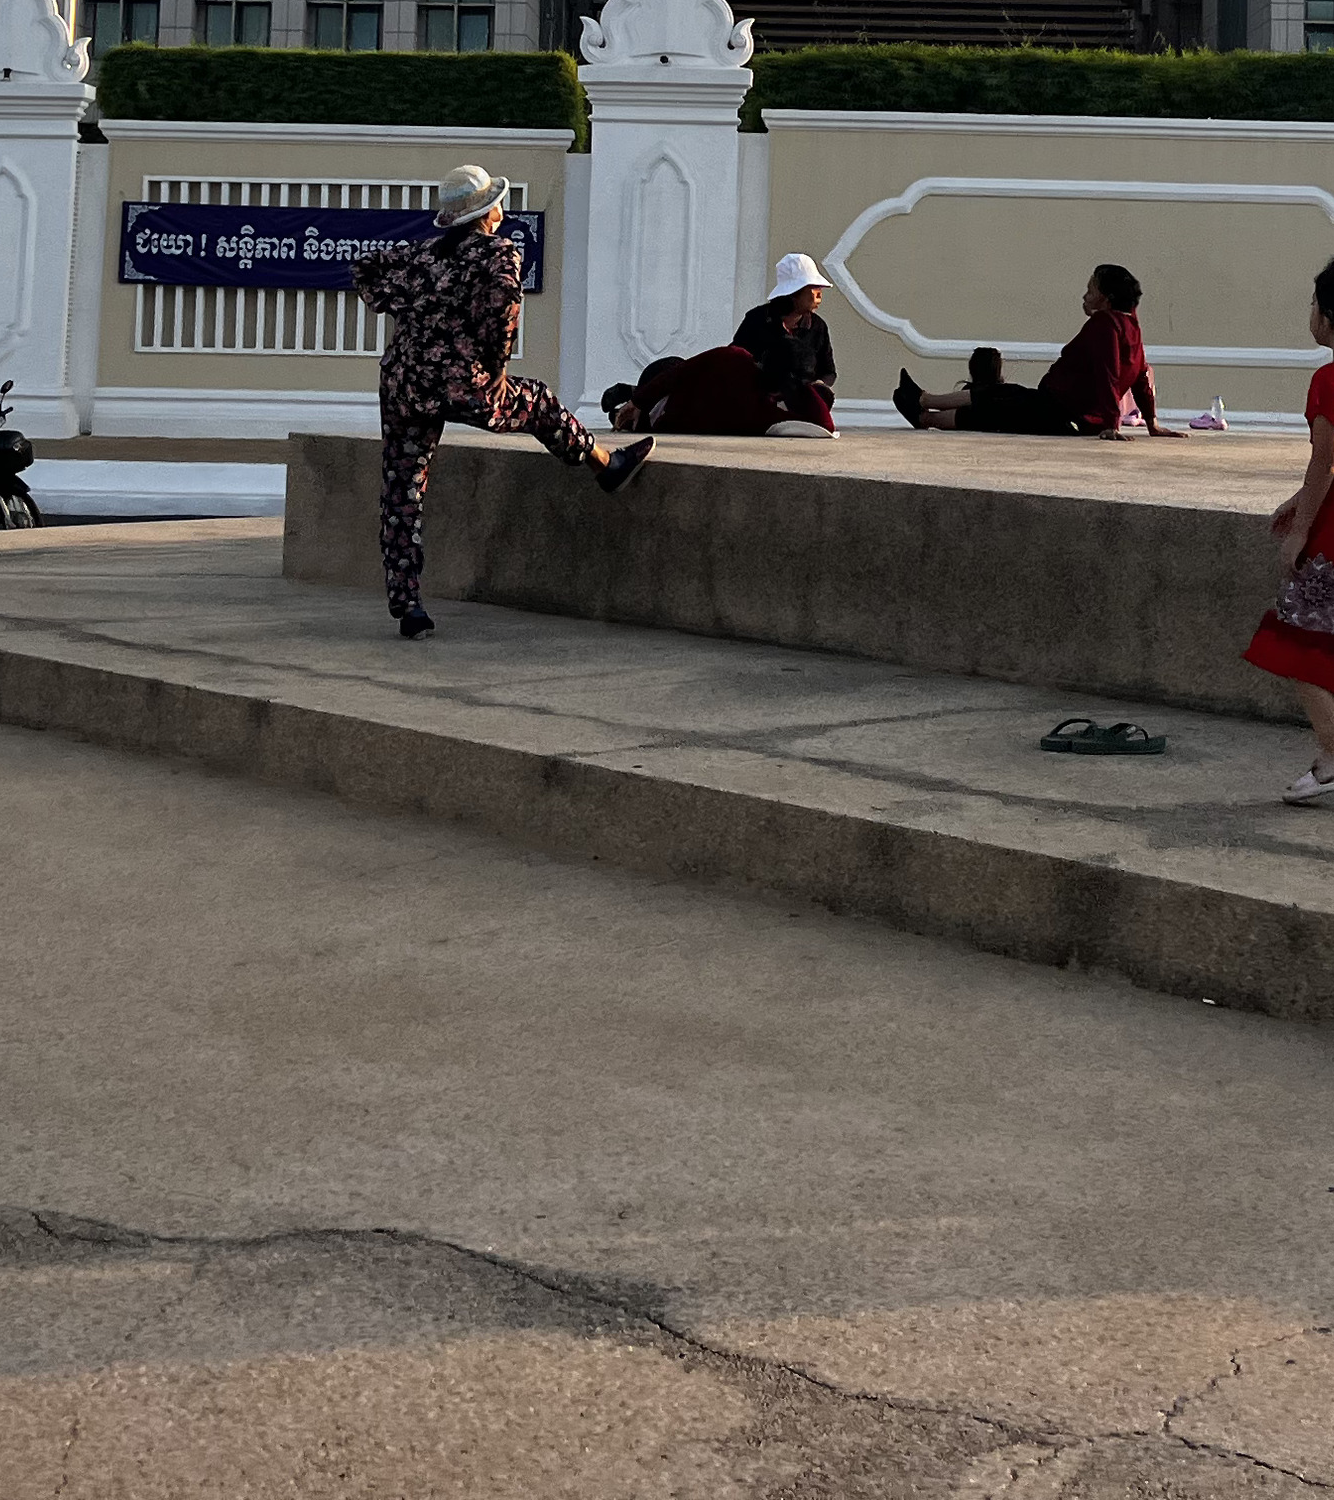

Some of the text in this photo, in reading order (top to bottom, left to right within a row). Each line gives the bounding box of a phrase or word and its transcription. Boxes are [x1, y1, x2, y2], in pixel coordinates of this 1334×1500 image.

[136, 228, 193, 256] ជយោ
[216, 225, 296, 269] សន្តិភាព
